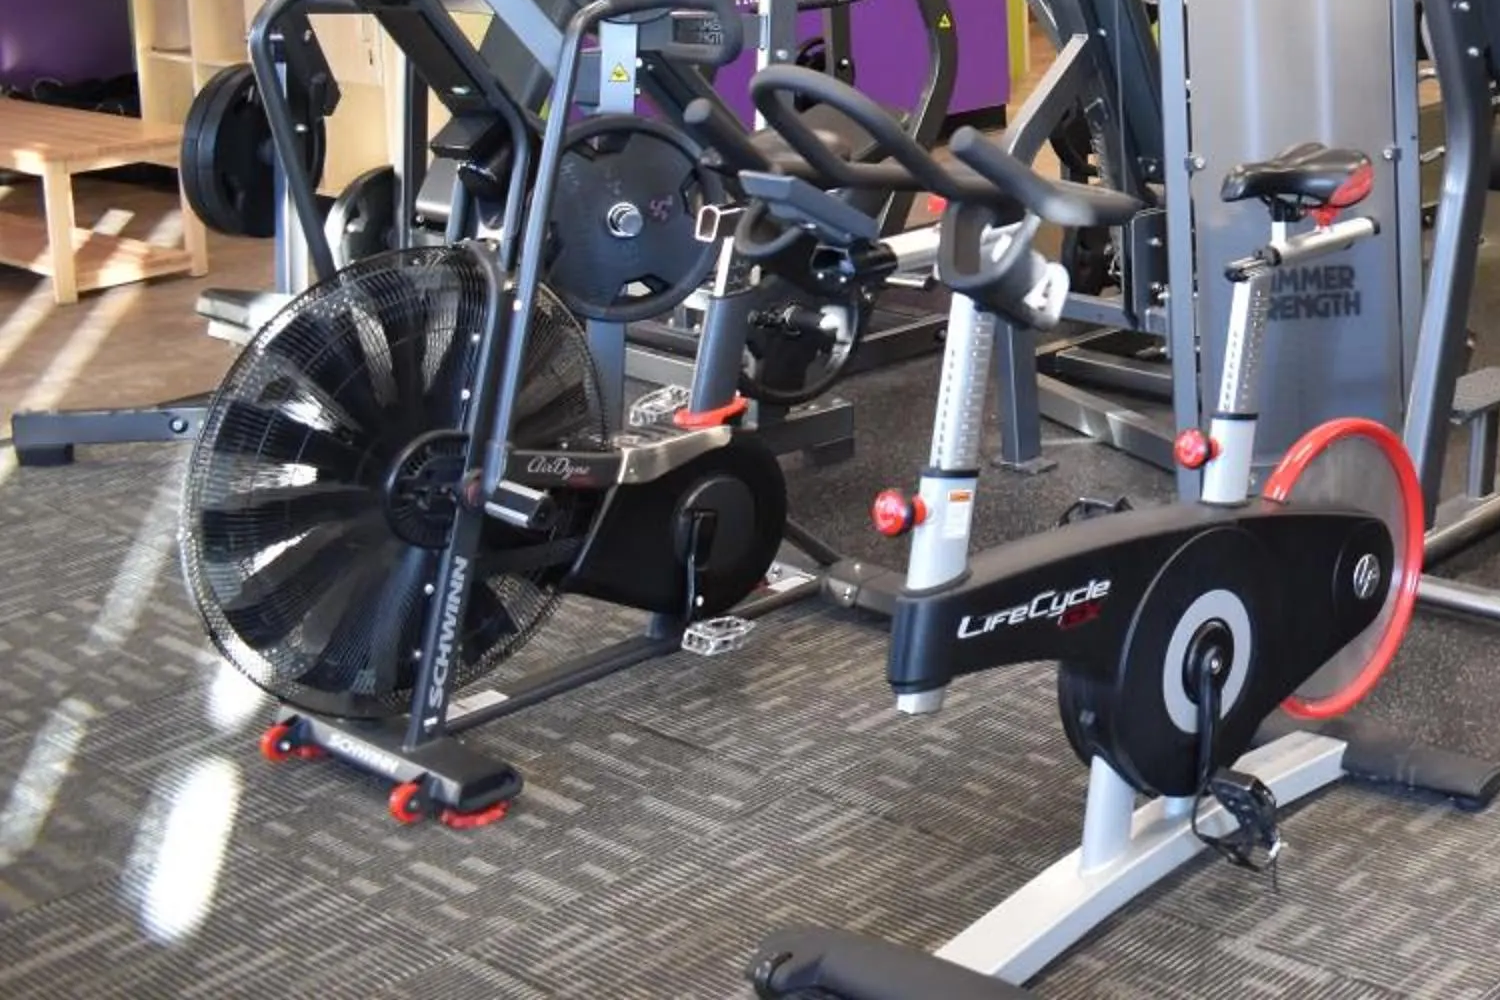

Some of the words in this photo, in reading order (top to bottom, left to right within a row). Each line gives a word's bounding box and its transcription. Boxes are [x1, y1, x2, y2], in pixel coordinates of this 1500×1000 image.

[1271, 265, 1355, 293] MMER
[527, 455, 591, 481] AirDyne
[957, 579, 1112, 639] LifeCycle
[429, 556, 469, 709] SCHWINN
